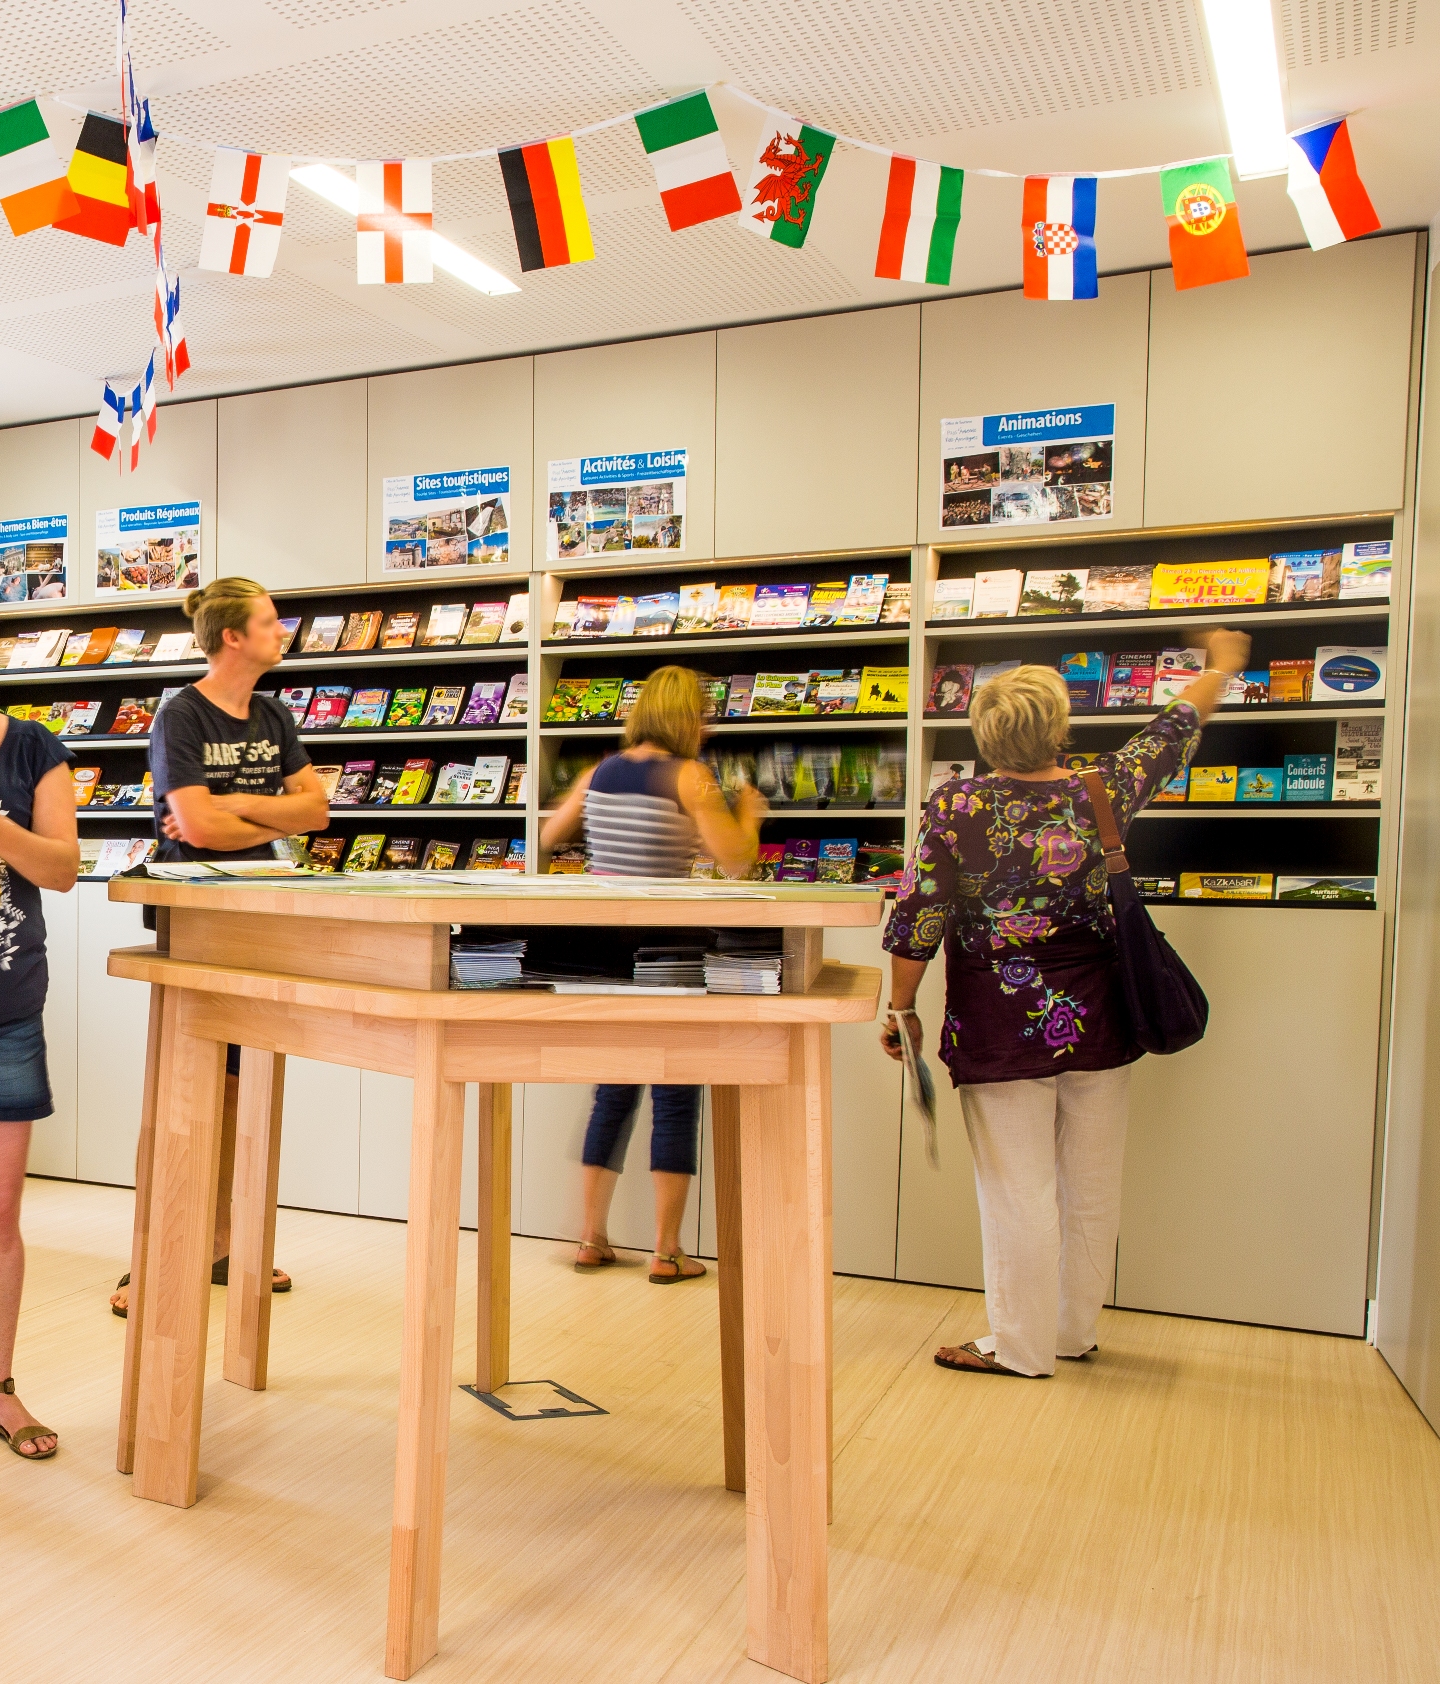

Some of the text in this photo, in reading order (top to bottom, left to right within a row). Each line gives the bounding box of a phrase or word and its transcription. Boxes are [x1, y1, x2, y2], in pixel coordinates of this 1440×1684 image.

[998, 412, 1082, 432] Animations
[583, 452, 686, 474] Activités & Loisirs
[416, 477, 441, 491] Sites
[443, 471, 508, 488] touristiques
[121, 507, 199, 522] Produits Régionaux
[26, 522, 31, 530] &
[32, 517, 67, 529] Bien-être
[1180, 585, 1236, 599] du JEU
[1286, 778, 1325, 789] Laboule
